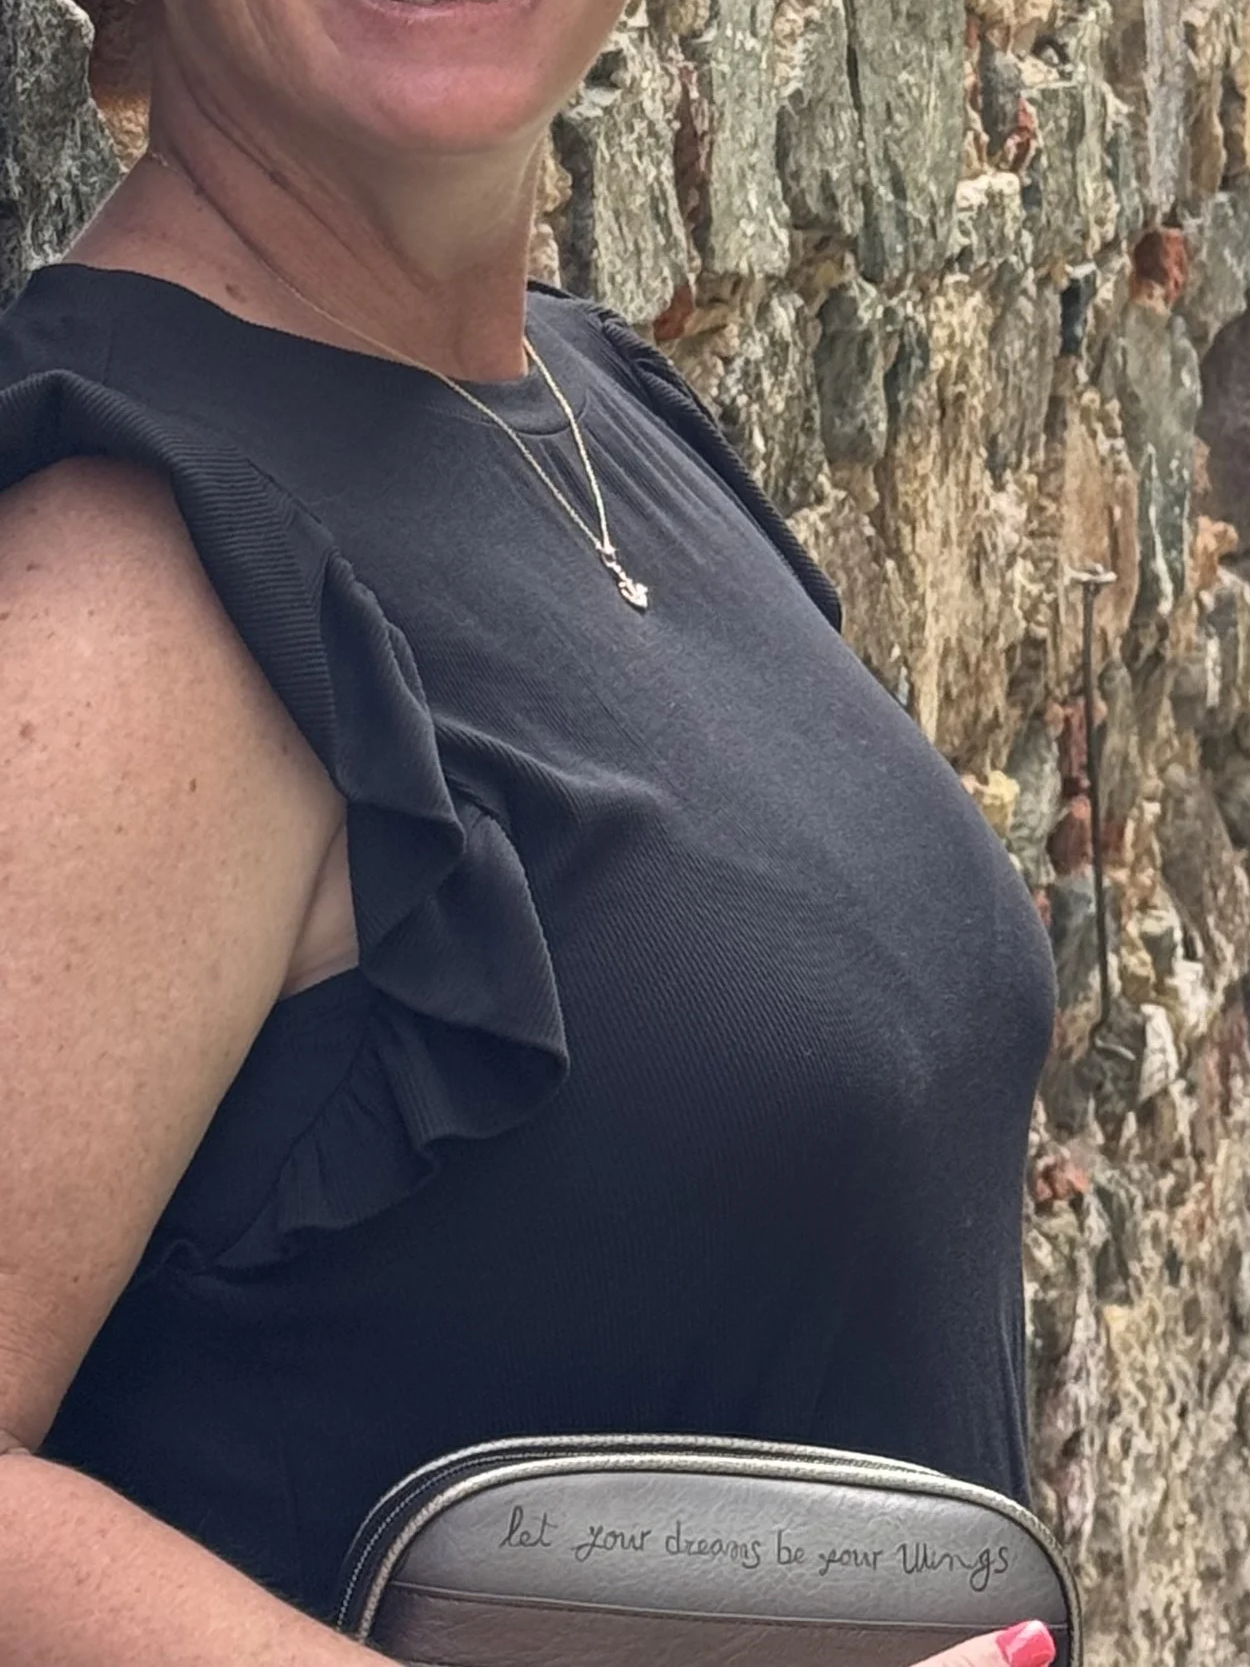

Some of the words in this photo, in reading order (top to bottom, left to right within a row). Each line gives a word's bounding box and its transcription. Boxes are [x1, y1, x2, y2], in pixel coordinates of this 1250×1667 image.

[499, 1504, 558, 1549] let
[571, 1523, 653, 1563] your
[664, 1519, 761, 1568] dreams
[776, 1528, 806, 1566] be
[818, 1547, 884, 1577] your
